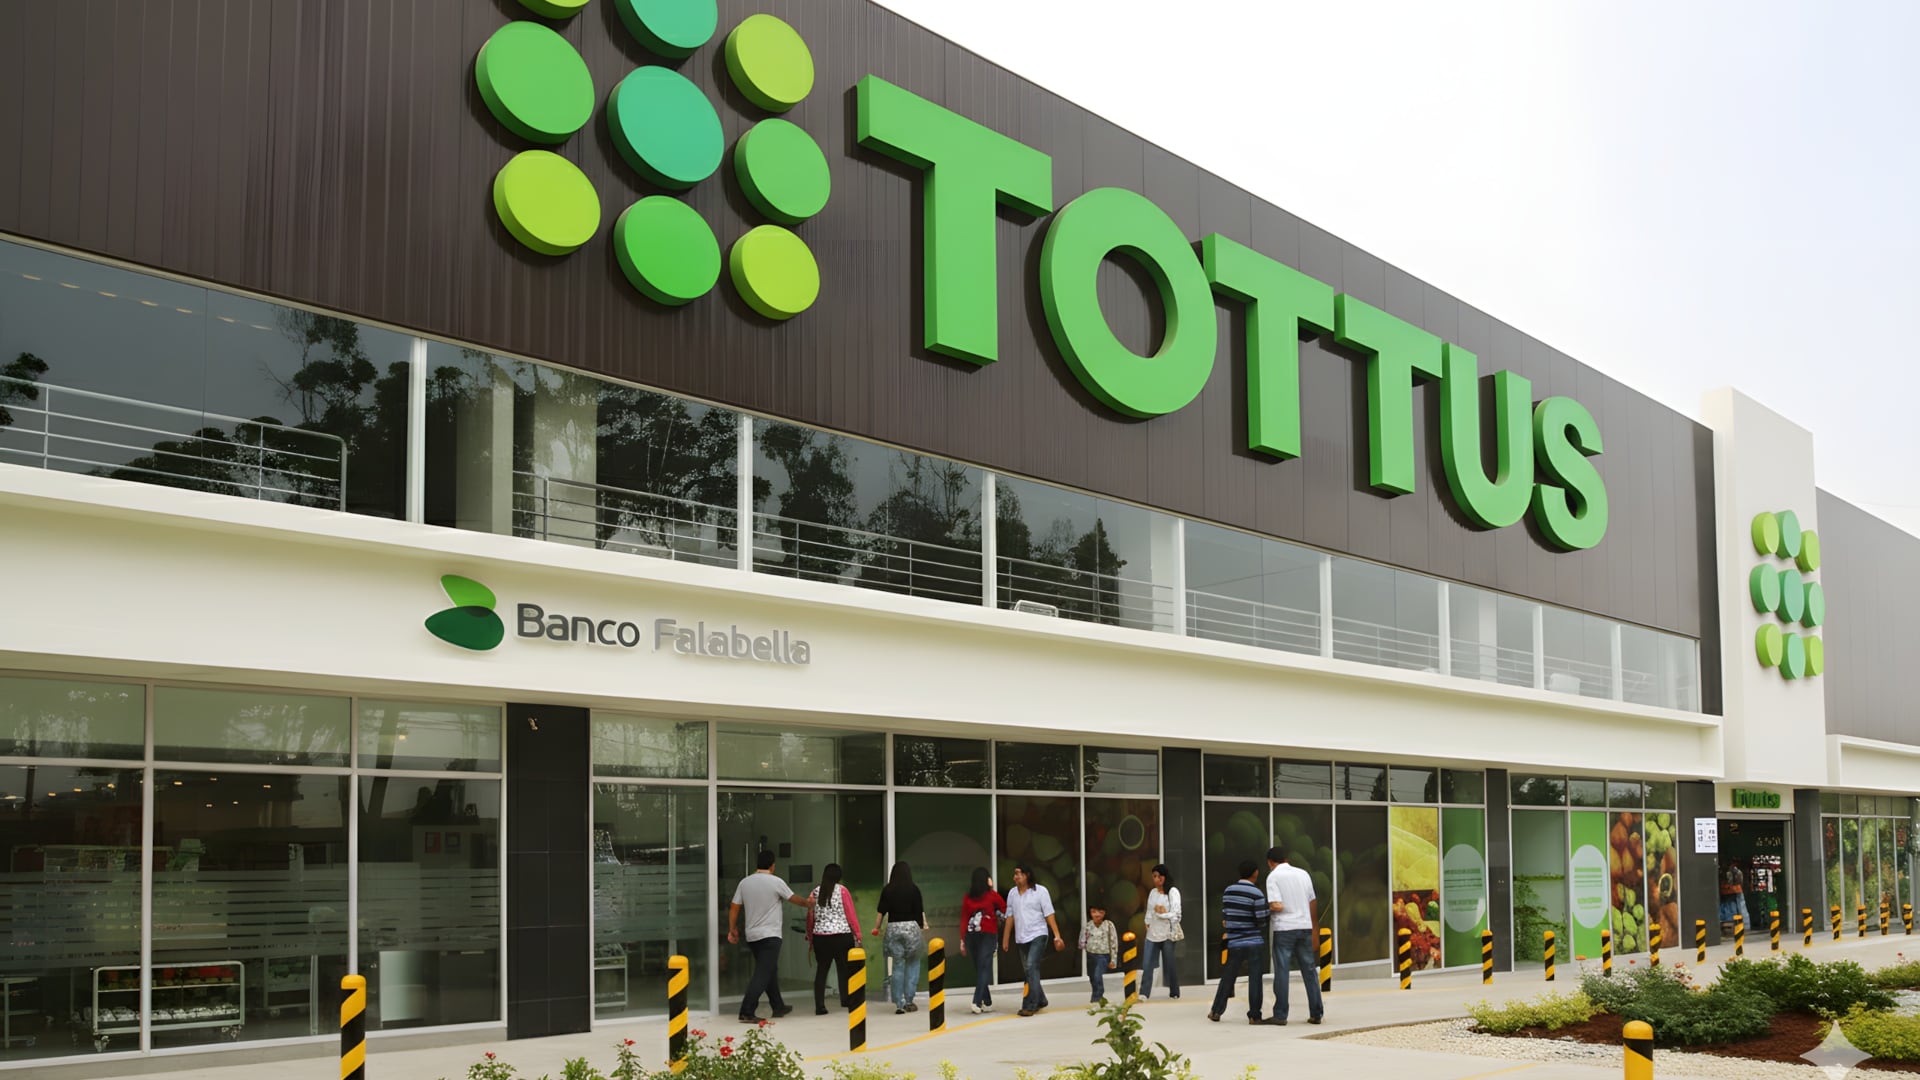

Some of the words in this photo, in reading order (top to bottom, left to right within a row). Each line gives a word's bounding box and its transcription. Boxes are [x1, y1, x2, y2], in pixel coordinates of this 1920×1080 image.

[857, 74, 1608, 550] TOTTUS
[517, 603, 640, 647] Banco
[654, 618, 811, 665] Falabella
